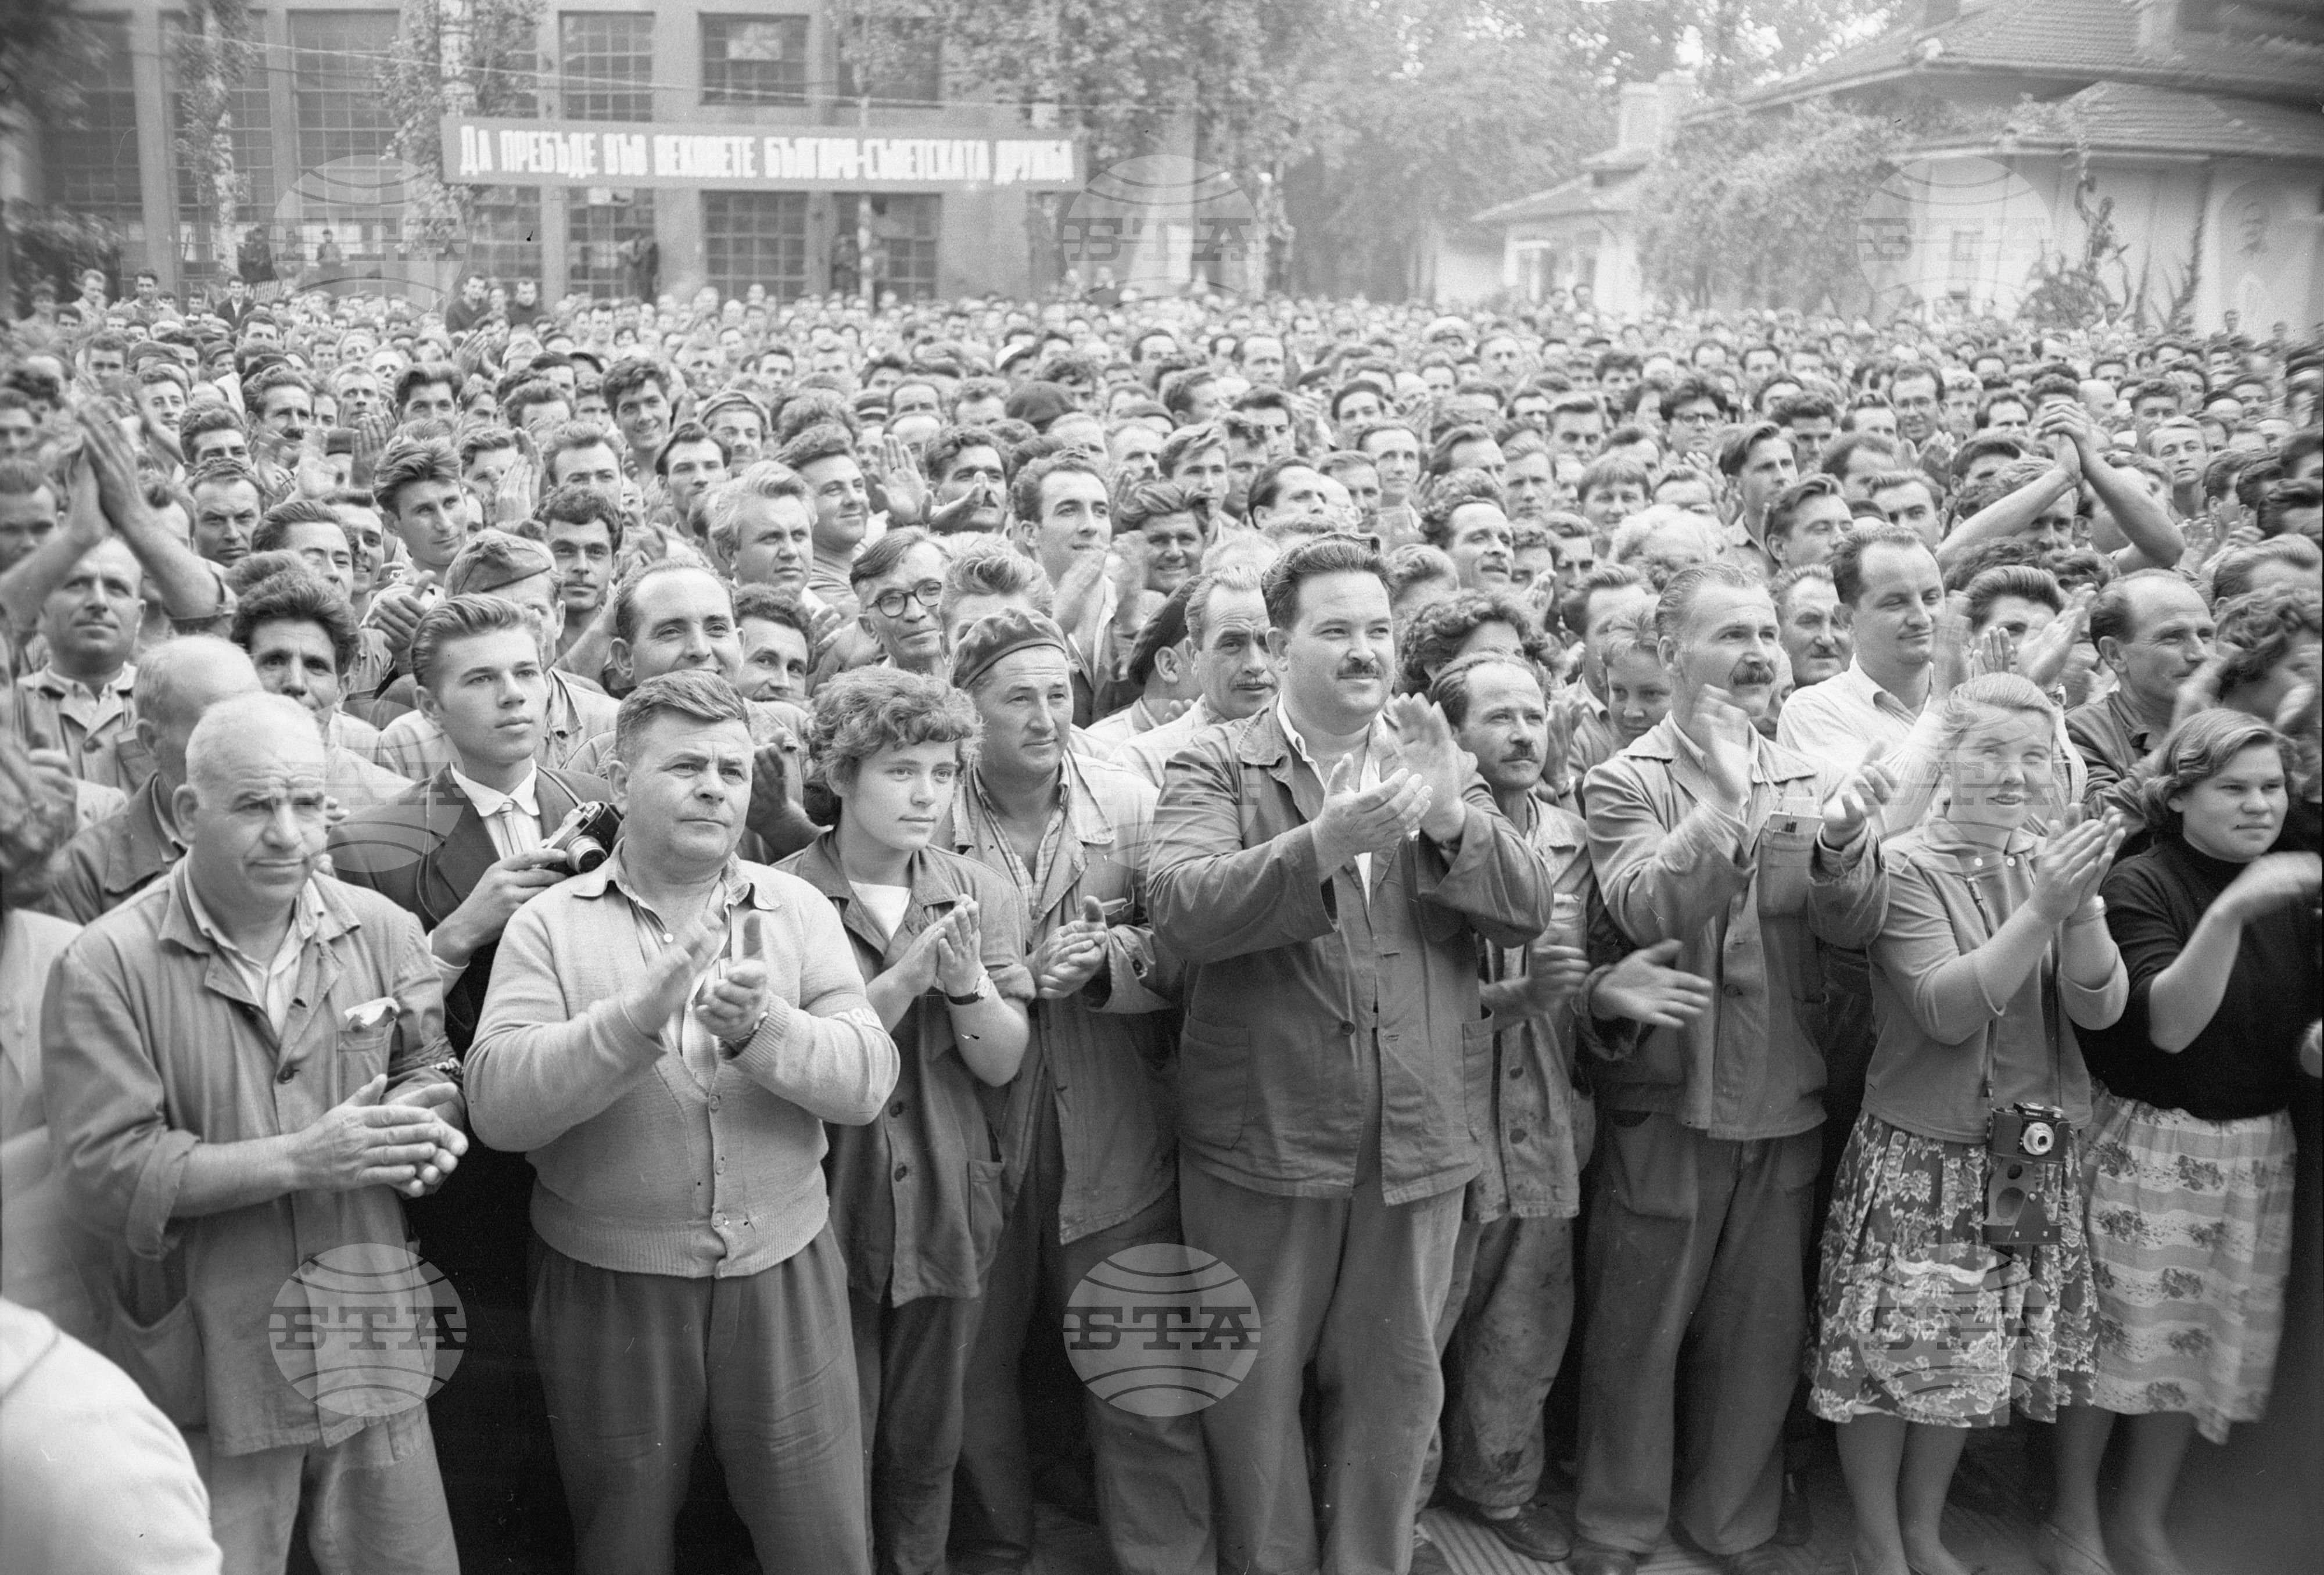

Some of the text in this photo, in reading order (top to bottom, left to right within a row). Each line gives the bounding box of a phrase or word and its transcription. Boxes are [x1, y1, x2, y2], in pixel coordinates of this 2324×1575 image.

[460, 125, 493, 176] ДА
[499, 130, 598, 178] ПРЕБЪДЕ
[602, 132, 648, 176] ВЪВ
